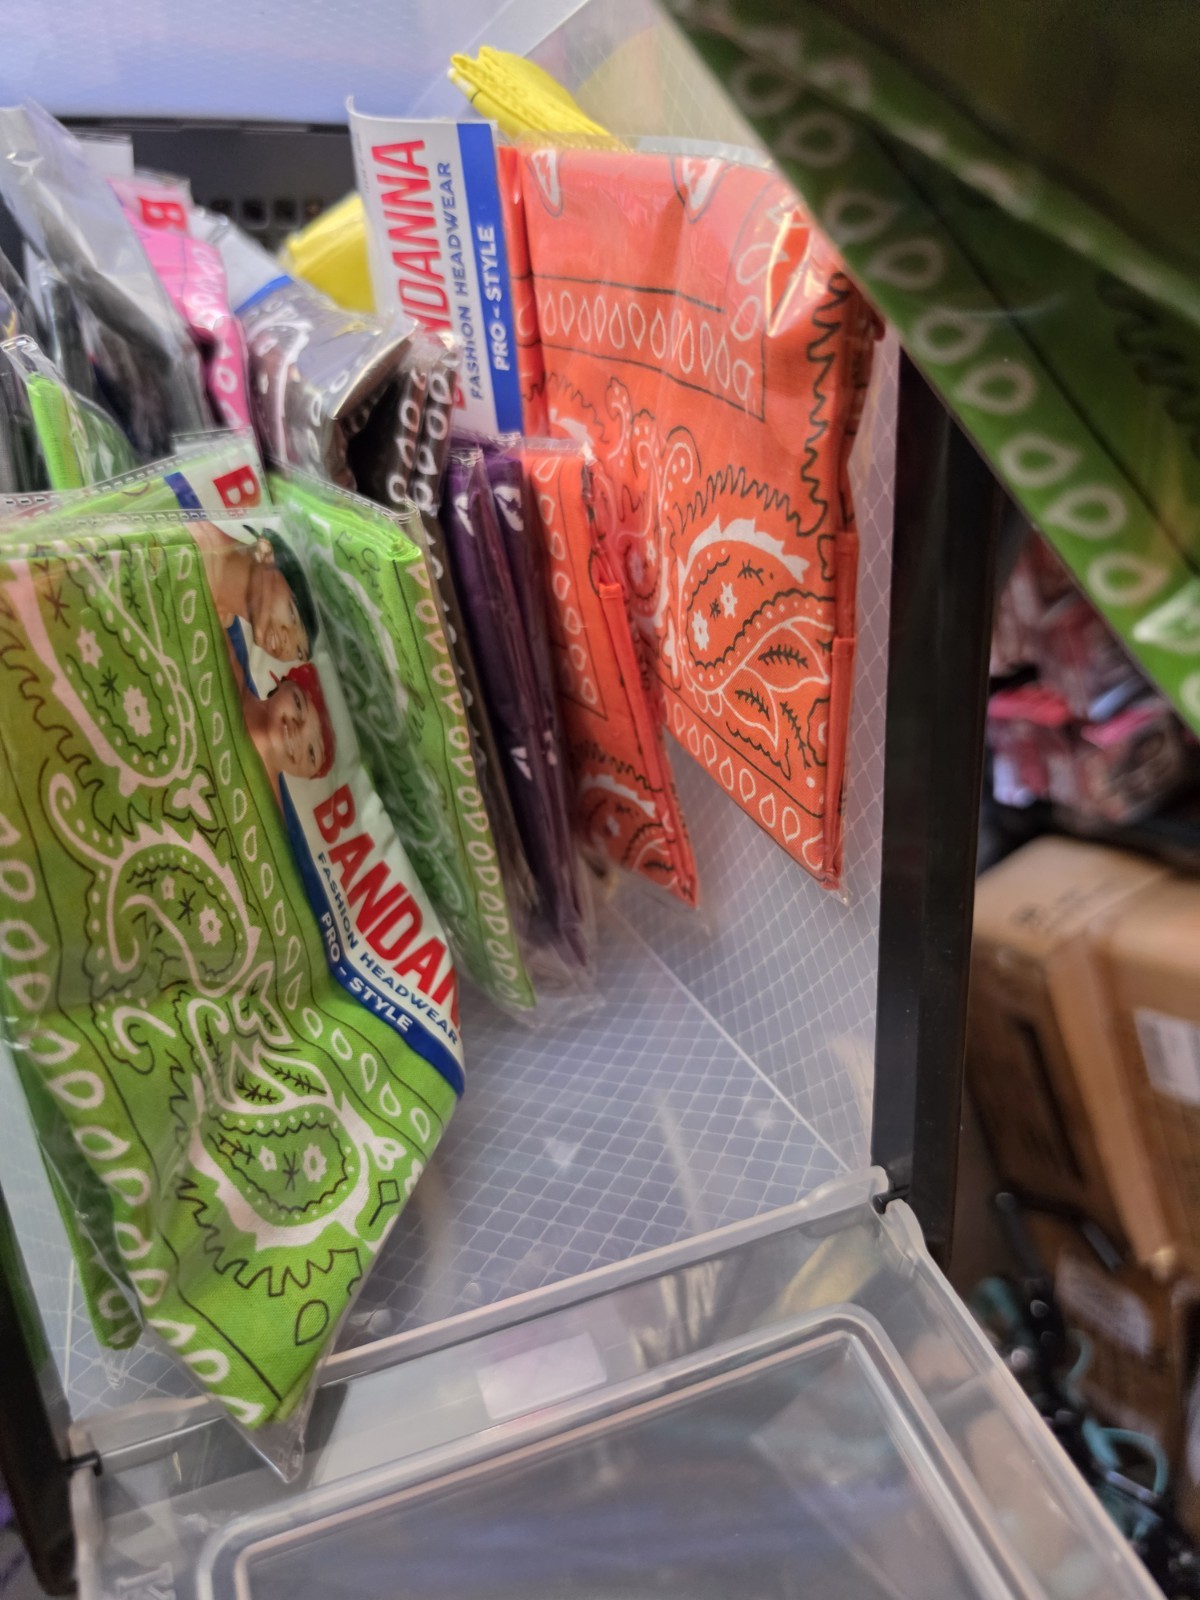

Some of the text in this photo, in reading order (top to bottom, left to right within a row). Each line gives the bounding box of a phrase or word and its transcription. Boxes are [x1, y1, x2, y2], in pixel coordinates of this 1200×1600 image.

[437, 162, 484, 400] FASHION HEADWEAR
[317, 853, 458, 1045] FASHION HEADWEAR
